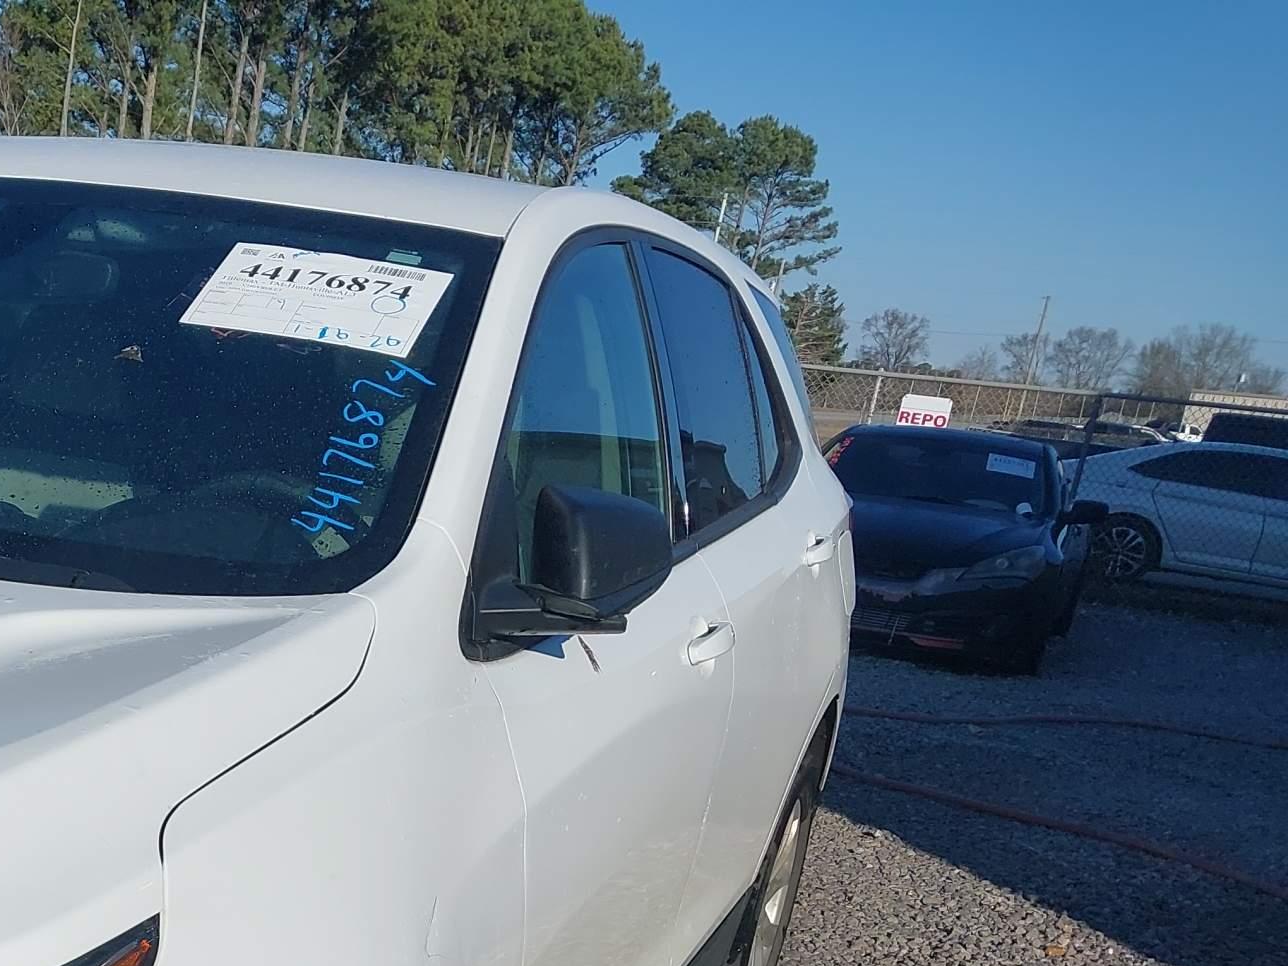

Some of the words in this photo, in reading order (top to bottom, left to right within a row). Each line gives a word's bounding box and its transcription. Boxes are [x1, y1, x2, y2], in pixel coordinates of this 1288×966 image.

[240, 263, 413, 300] 44176874
[898, 410, 947, 428] REPO
[290, 359, 438, 532] 44176874
